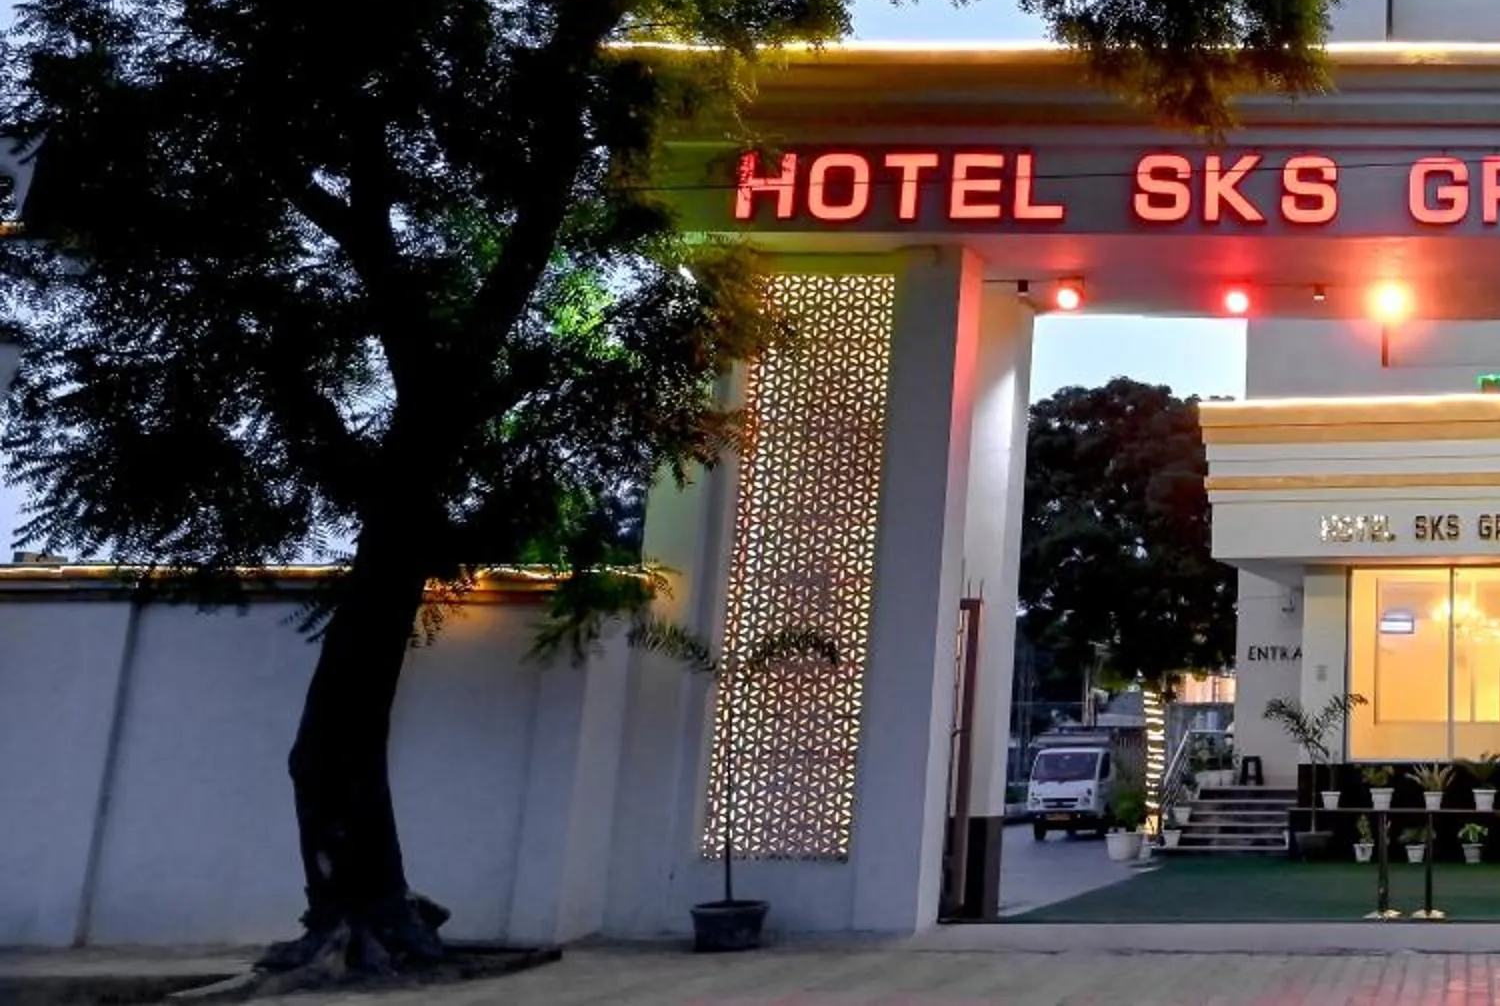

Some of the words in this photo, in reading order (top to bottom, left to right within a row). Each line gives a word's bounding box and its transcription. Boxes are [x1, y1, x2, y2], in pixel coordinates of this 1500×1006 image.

[736, 152, 1064, 222] HOTEL
[1133, 153, 1339, 224] SKS
[1414, 514, 1460, 541] SKS
[1247, 645, 1303, 662] ENTRA
